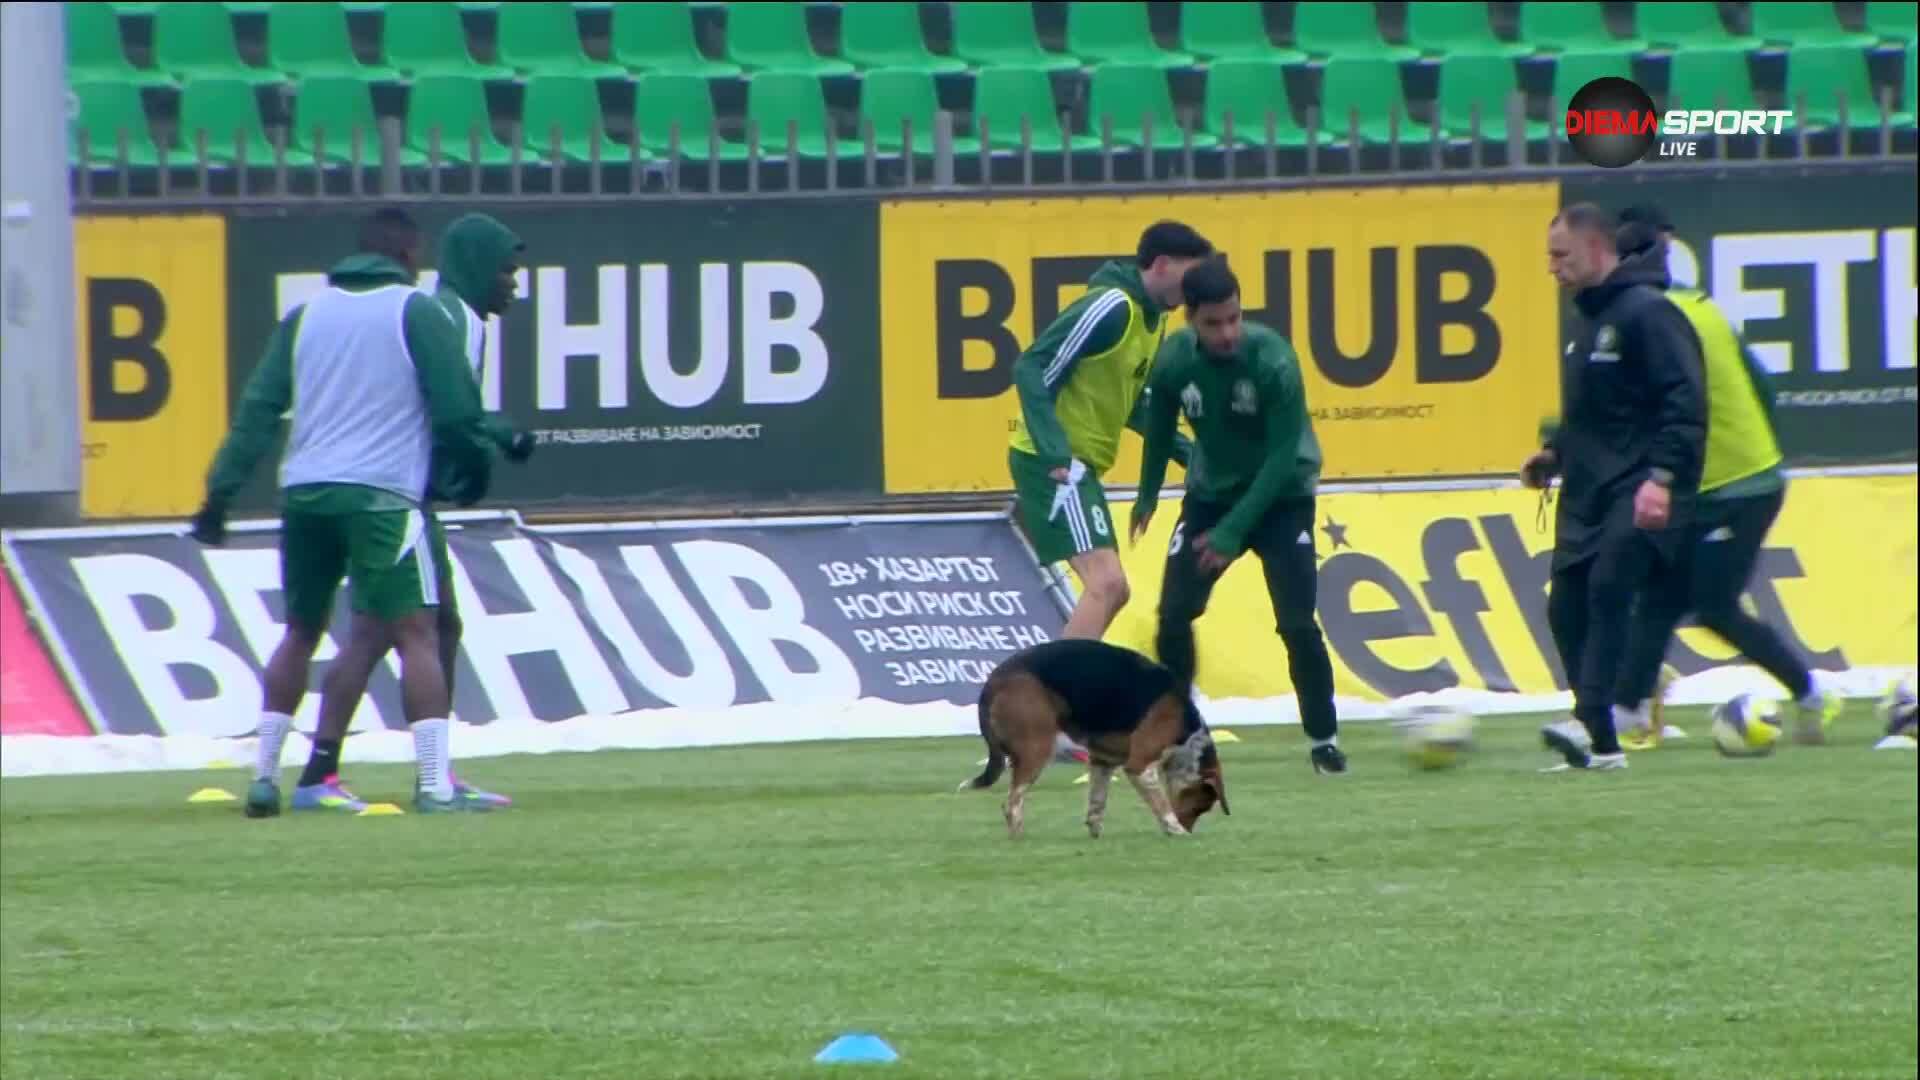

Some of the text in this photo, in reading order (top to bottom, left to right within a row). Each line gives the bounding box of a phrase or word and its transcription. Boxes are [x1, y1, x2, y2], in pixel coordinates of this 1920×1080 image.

[1091, 504, 1109, 536] 8
[818, 556, 999, 588] 18+ ХАЗАРТЪТ
[834, 591, 1027, 620] НОСИ РИСК ОТ
[853, 625, 1016, 653] РАЗВИВАНЕ
[884, 658, 998, 687] ЗАВИСИ
